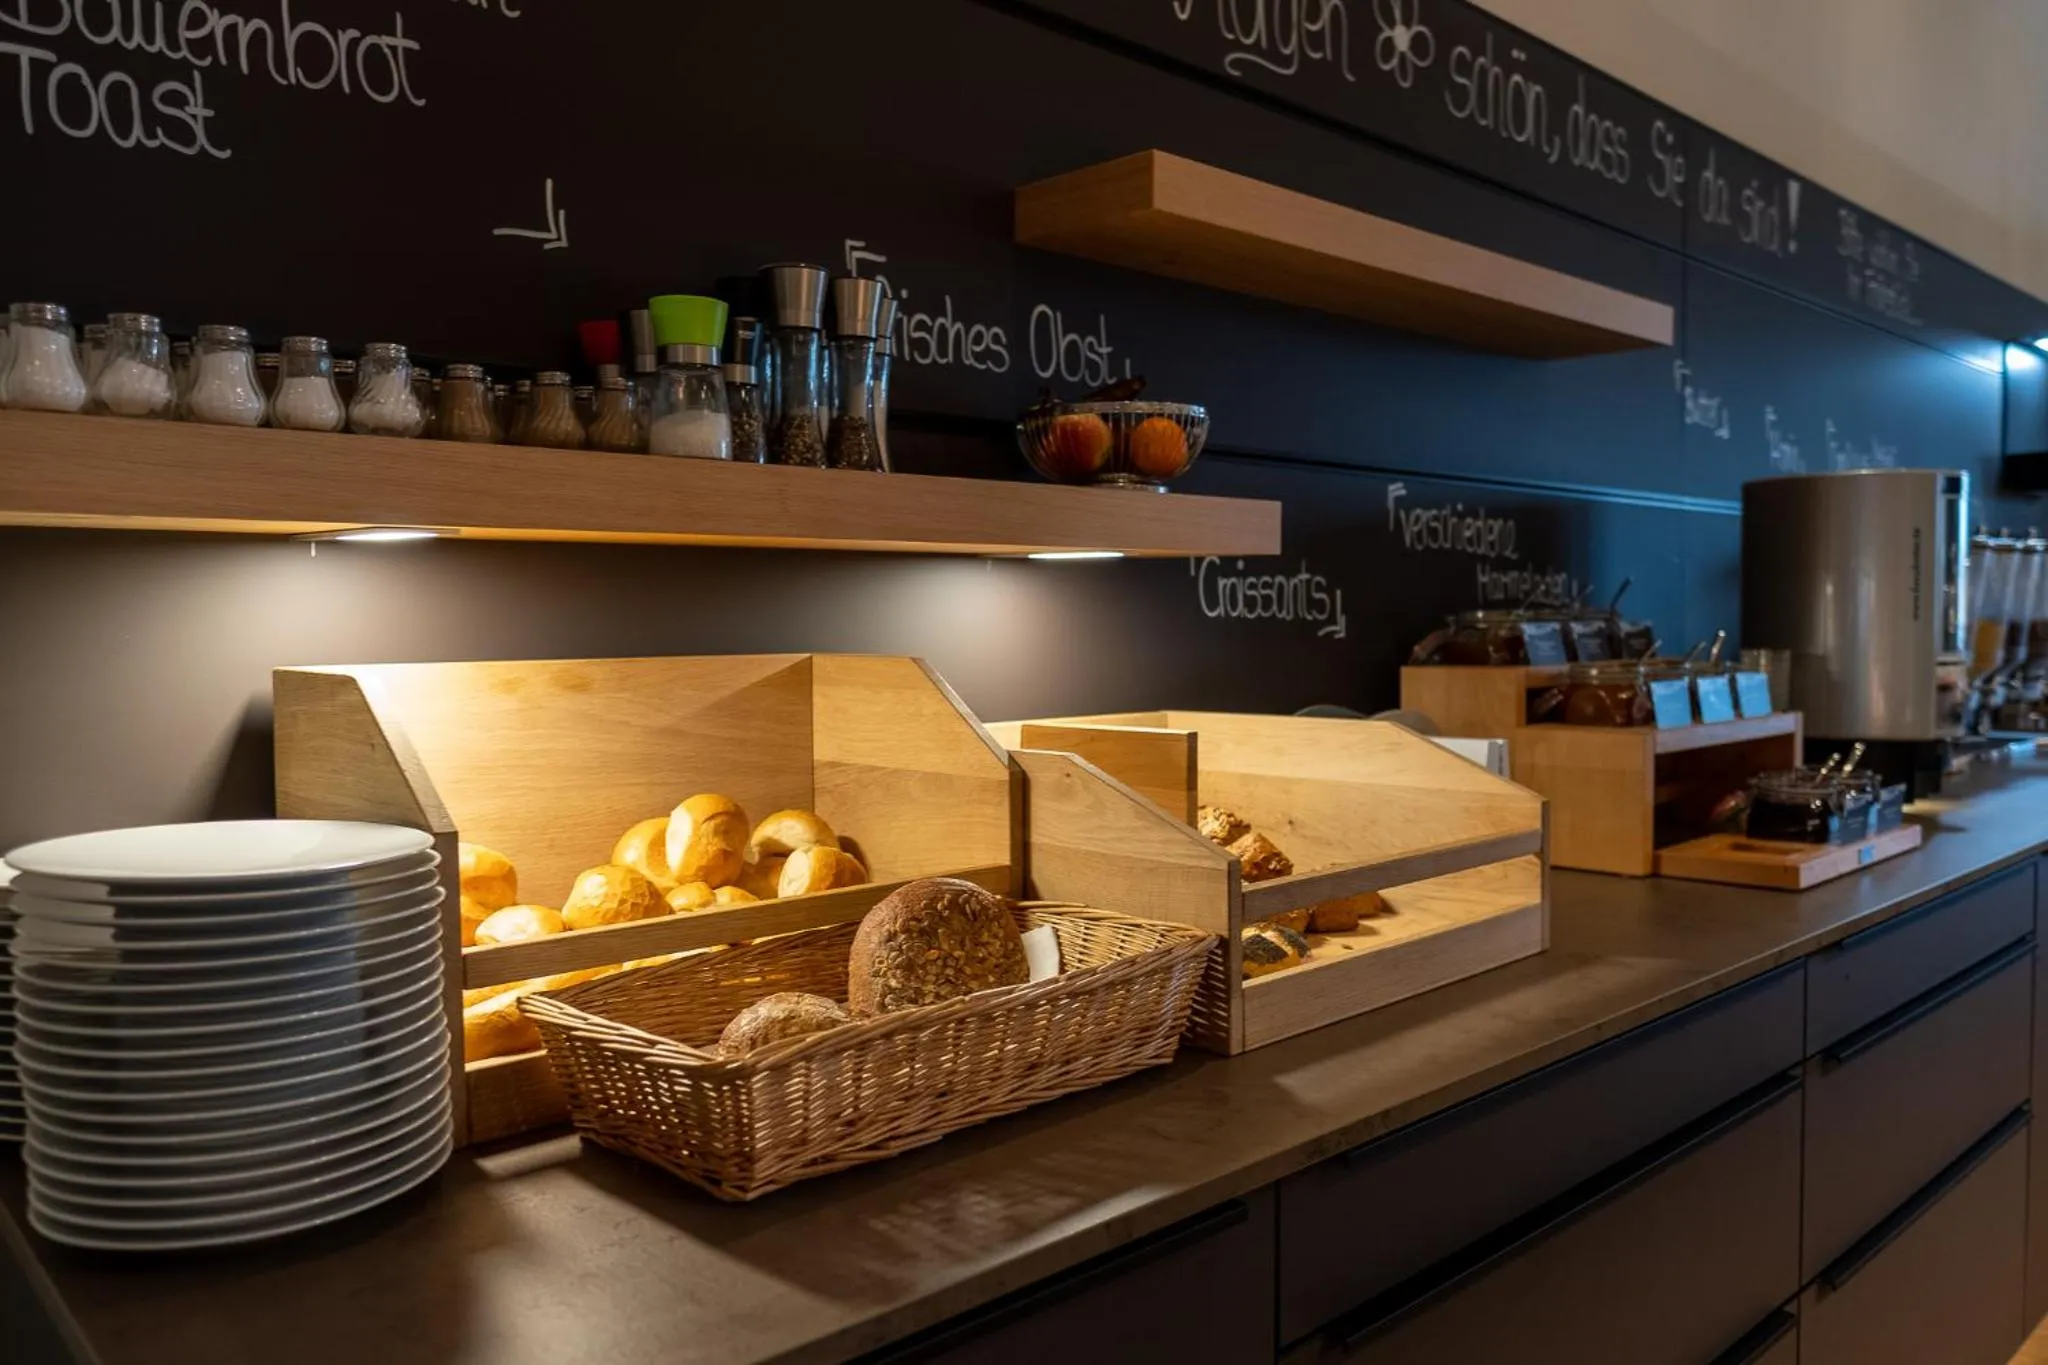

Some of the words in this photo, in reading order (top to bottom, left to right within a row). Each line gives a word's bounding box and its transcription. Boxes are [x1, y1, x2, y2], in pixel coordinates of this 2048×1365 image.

[0, 42, 232, 159] Toast
[1172, 0, 1357, 82] orgen
[1444, 30, 1561, 163] schön,
[1566, 71, 1631, 184] dass
[1646, 119, 1685, 207] Sie
[1698, 146, 1732, 225] da
[876, 275, 1010, 374] isches
[1030, 304, 1117, 387] Obst
[1198, 555, 1331, 622] Croissants
